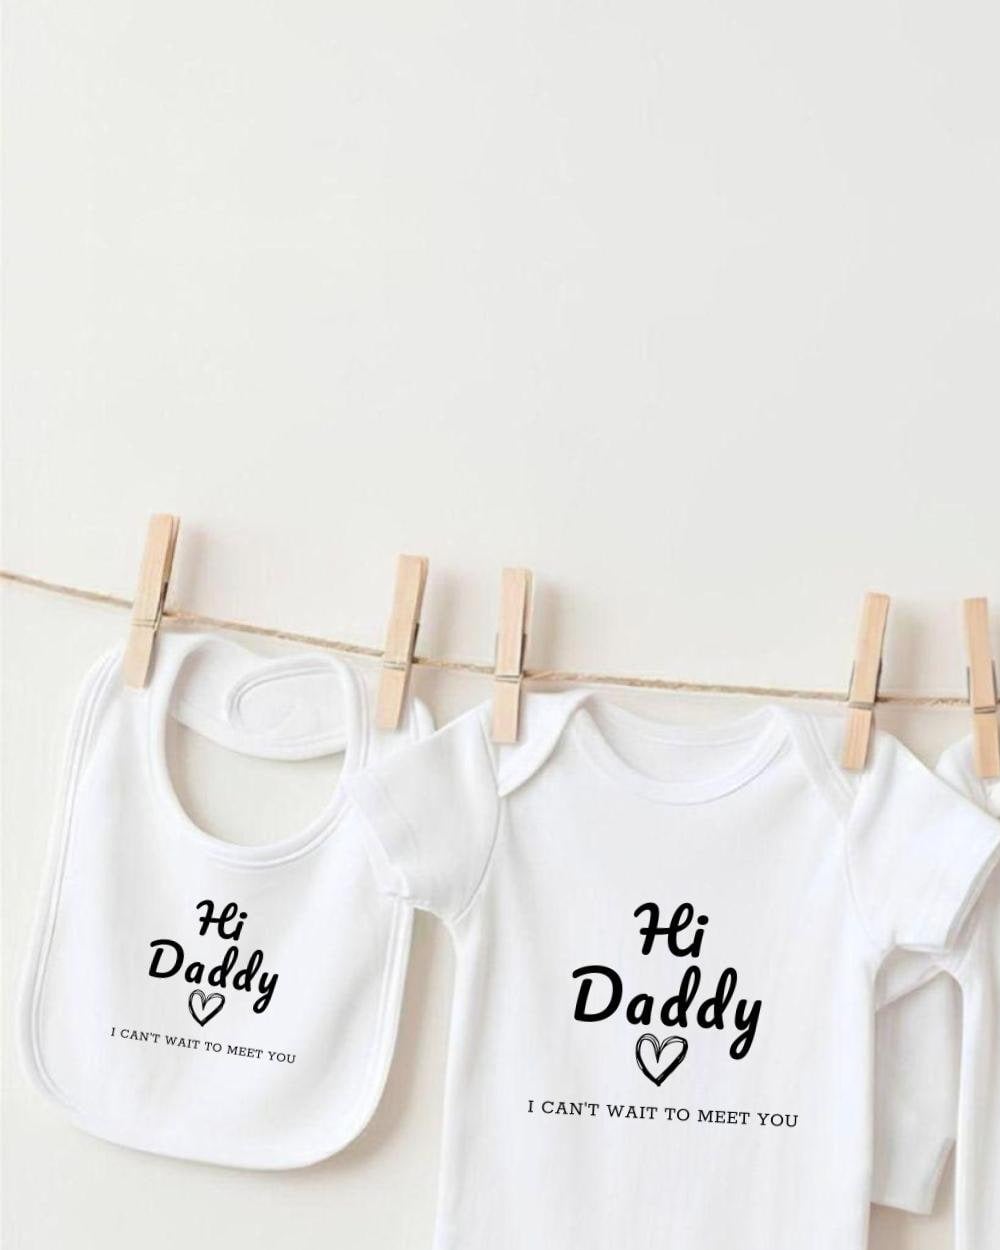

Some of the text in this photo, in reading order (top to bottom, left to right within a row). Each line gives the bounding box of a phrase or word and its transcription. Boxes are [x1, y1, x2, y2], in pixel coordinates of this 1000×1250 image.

[195, 899, 248, 942] Hi
[633, 901, 710, 959] Hi
[148, 938, 279, 1015] Daddy
[571, 964, 763, 1061] Daddy
[110, 1027, 296, 1064] I CAN'T WAIT TO MEET YOU
[527, 1099, 799, 1128] I CAN'T WAIT TO MEET YOU
